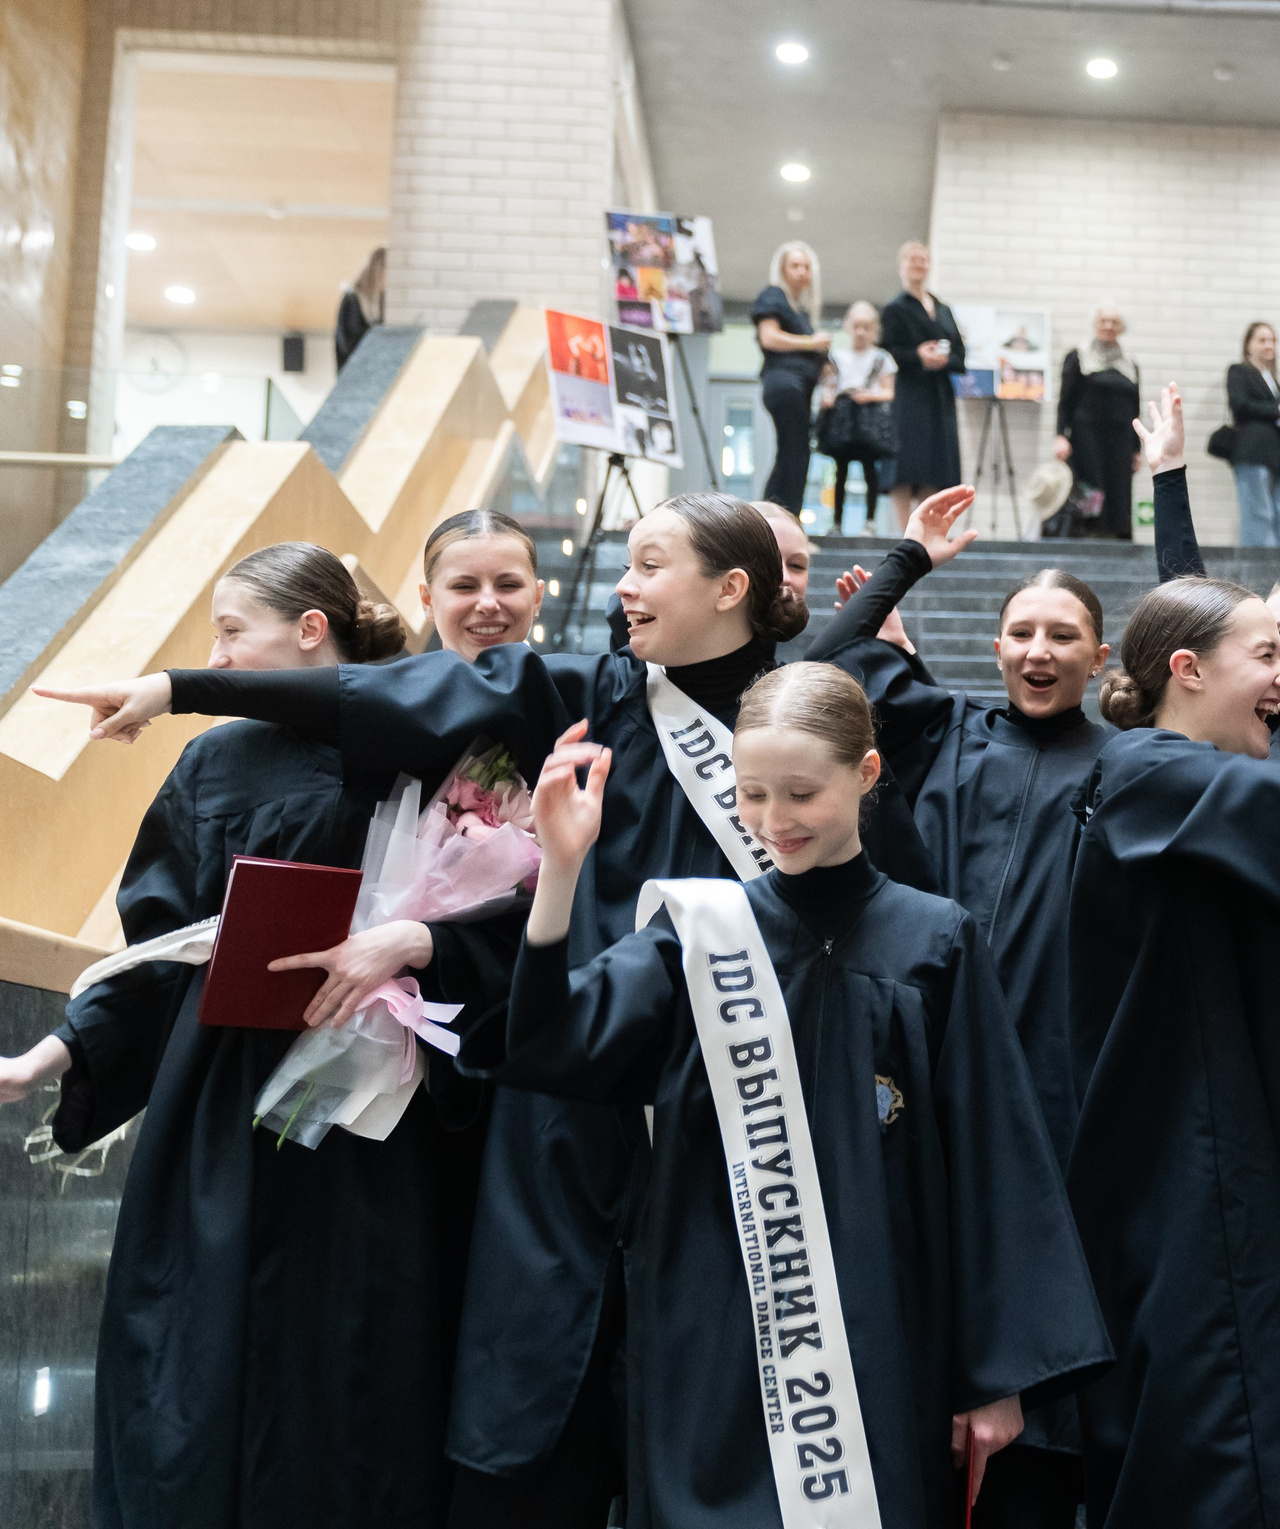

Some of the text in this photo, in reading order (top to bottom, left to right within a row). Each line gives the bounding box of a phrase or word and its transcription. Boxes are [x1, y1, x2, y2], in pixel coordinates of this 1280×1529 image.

[670, 715, 733, 781] IDC
[706, 948, 767, 1026] IDC
[726, 1035, 825, 1360] ВЫПУСКНИК
[733, 1161, 784, 1434] INTERNATIONAL DANCE CENTER
[783, 1370, 851, 1504] 2025
